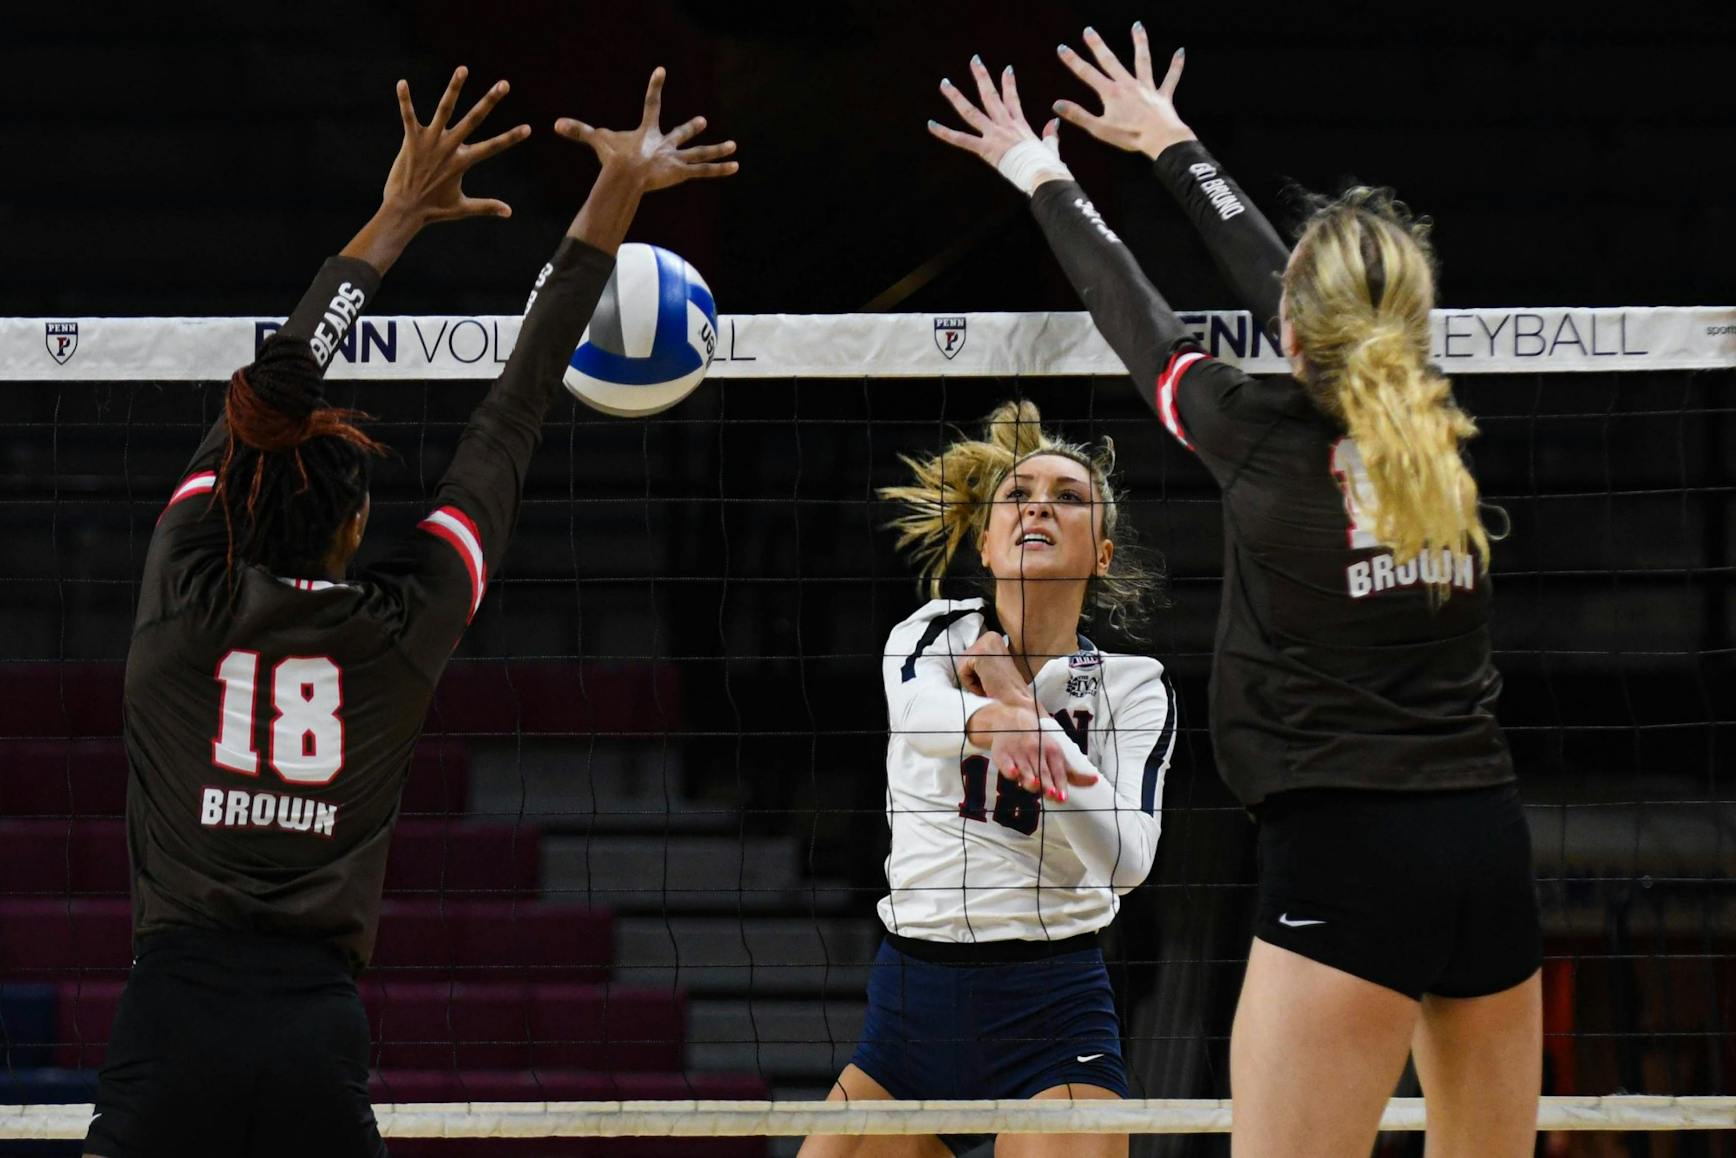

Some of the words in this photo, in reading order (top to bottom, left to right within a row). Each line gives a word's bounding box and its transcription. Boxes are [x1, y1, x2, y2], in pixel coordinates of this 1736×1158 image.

[1200, 177, 1246, 222] BRUNO
[48, 324, 76, 333] PENN
[309, 282, 365, 367] BEARS
[936, 319, 964, 328] PENN
[944, 331, 959, 351] P
[1434, 313, 1649, 357] EYBALL
[56, 336, 71, 357] P
[1346, 548, 1474, 598] BROWN
[212, 649, 345, 785] 18
[200, 787, 338, 837] BROWN
